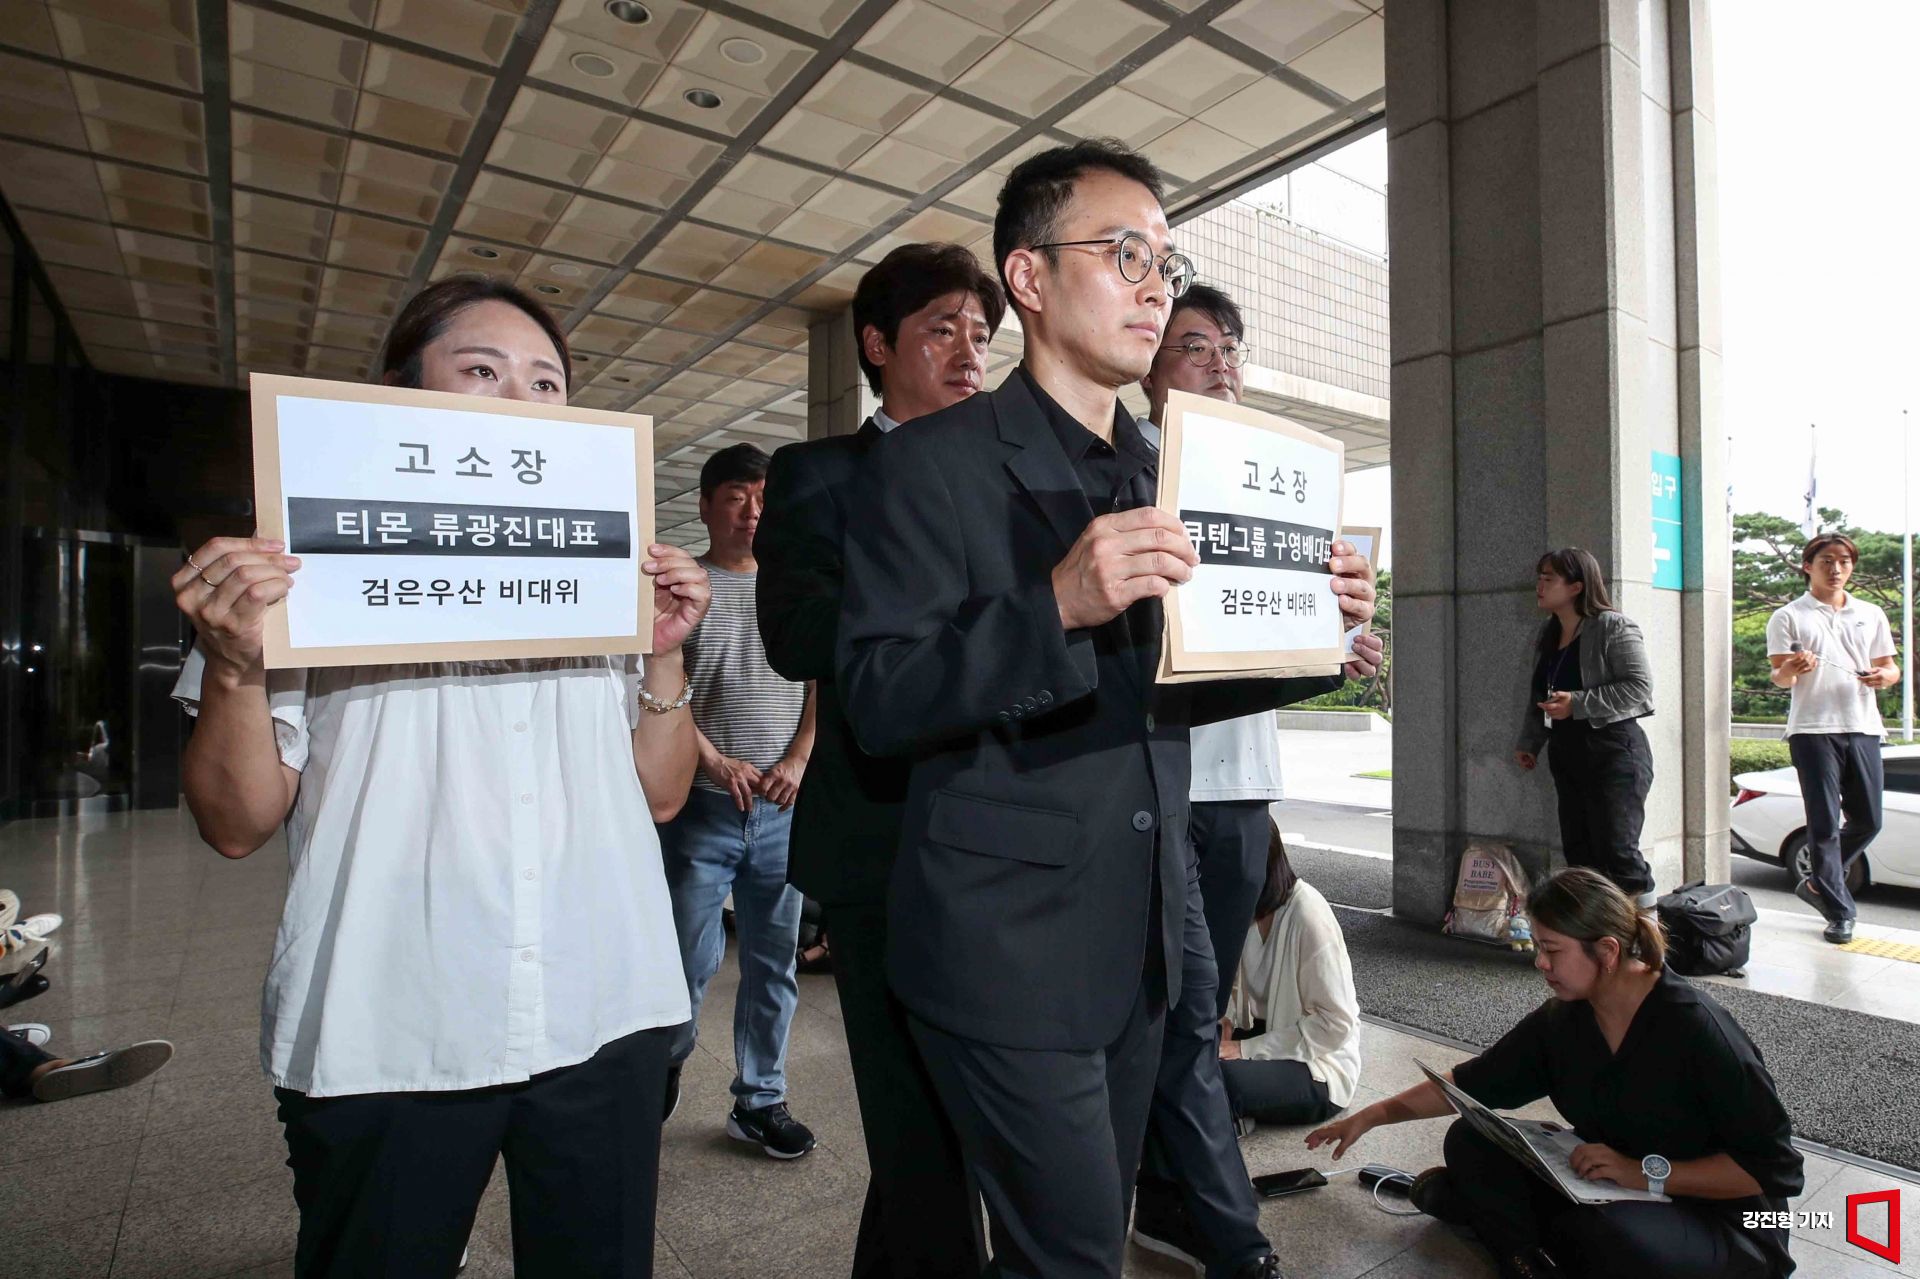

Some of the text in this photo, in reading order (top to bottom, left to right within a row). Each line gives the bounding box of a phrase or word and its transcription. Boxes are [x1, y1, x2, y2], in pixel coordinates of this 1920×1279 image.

[335, 509, 600, 549] 티몬 류광진대표
[1272, 530, 1332, 565] 구영배대표
[361, 578, 579, 606] 검은우산 비대위
[1220, 589, 1317, 617] 검은우산 비대위
[1470, 870, 1494, 879] BABE
[1473, 859, 1496, 869] BUSY
